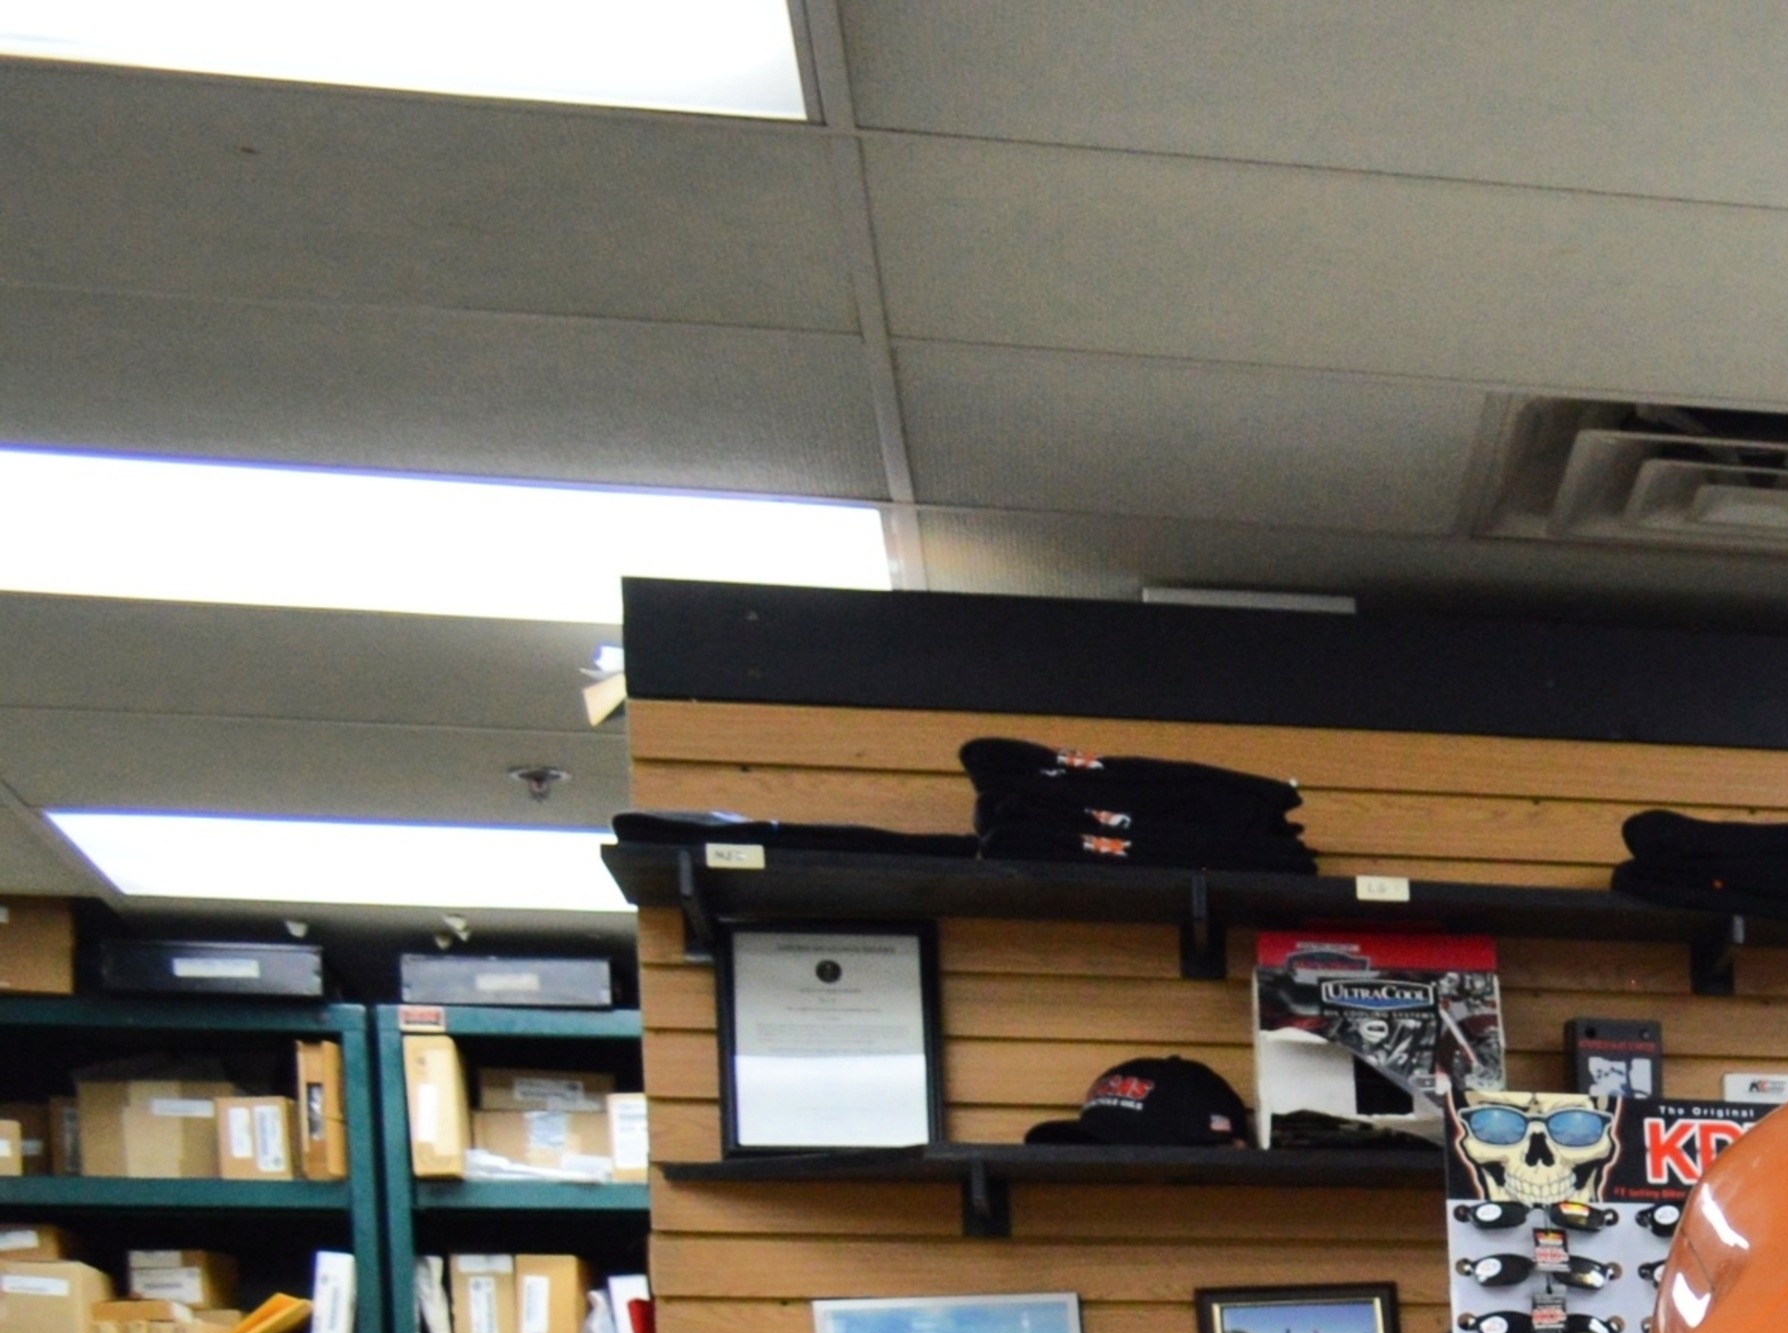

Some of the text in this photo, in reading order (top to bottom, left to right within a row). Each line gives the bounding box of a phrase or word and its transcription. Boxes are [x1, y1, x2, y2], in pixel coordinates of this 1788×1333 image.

[1658, 1104, 1755, 1119] The Original
[1643, 1118, 1757, 1185] KD
